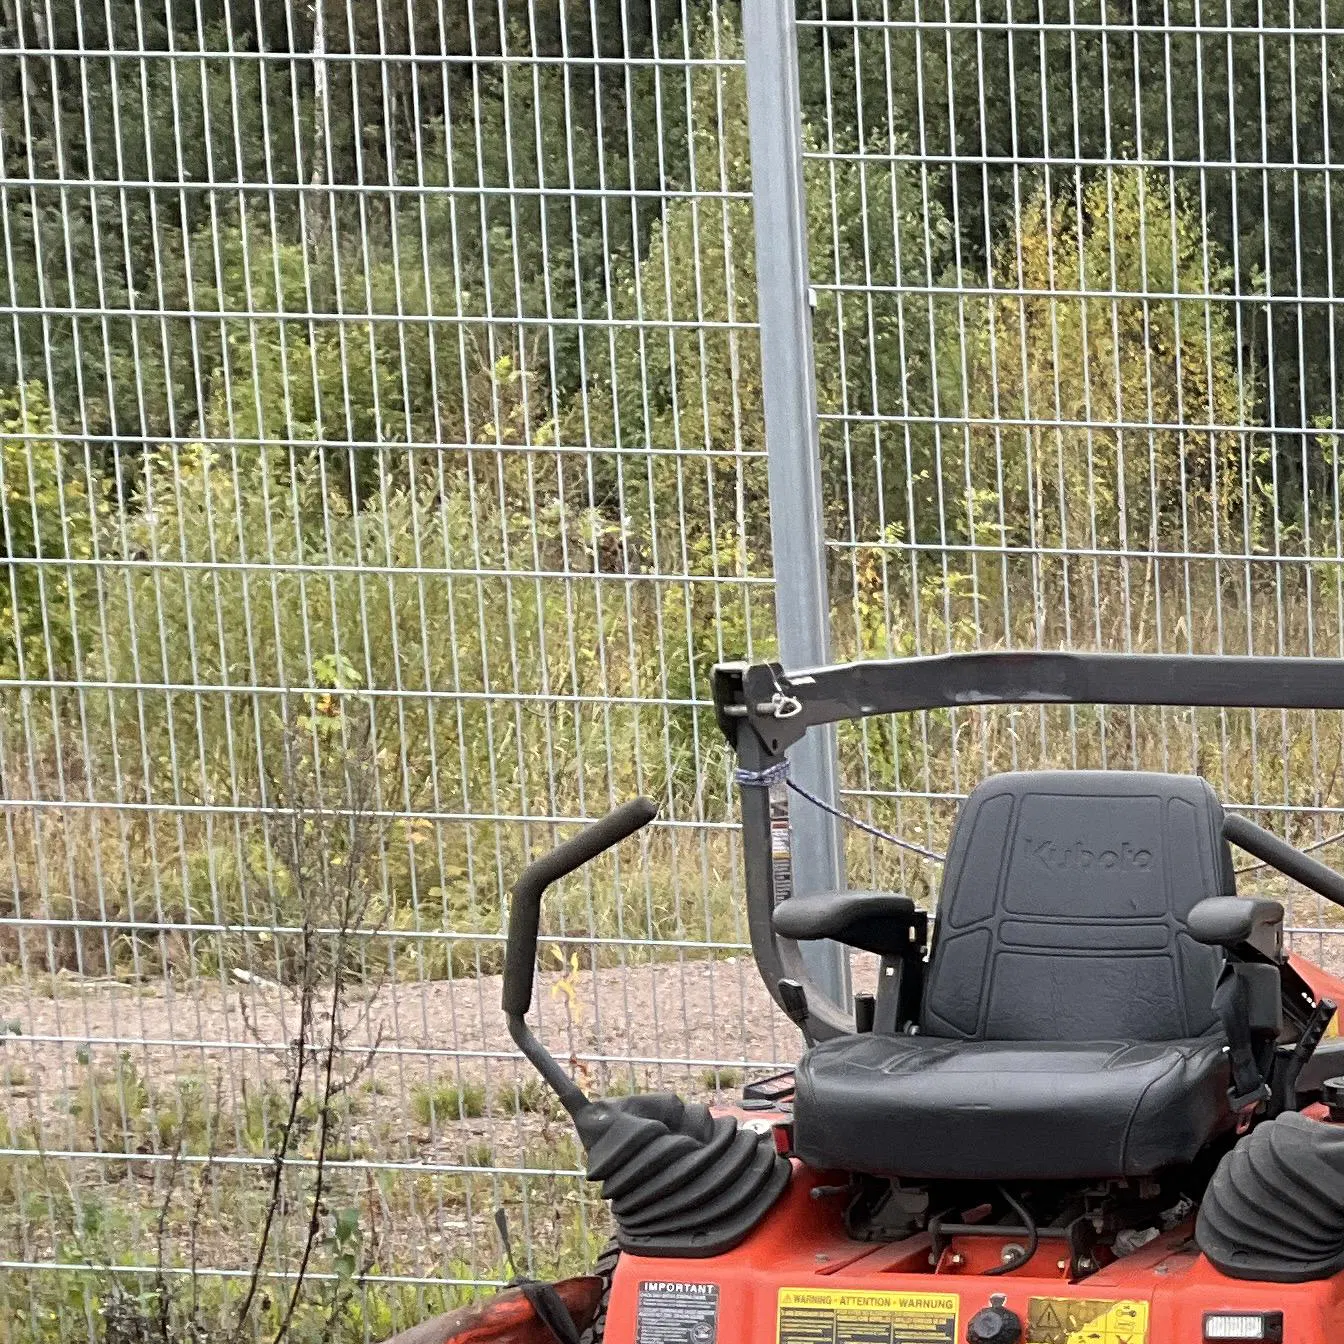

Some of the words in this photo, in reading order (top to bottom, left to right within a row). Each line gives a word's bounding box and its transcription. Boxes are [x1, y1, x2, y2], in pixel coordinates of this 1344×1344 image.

[1023, 837, 1153, 873] Kubota
[644, 1282, 715, 1294] IMPORTANT
[793, 1295, 832, 1305] WARNING
[839, 1296, 891, 1307] ATTENTION
[899, 1297, 954, 1310] WARNUNG
